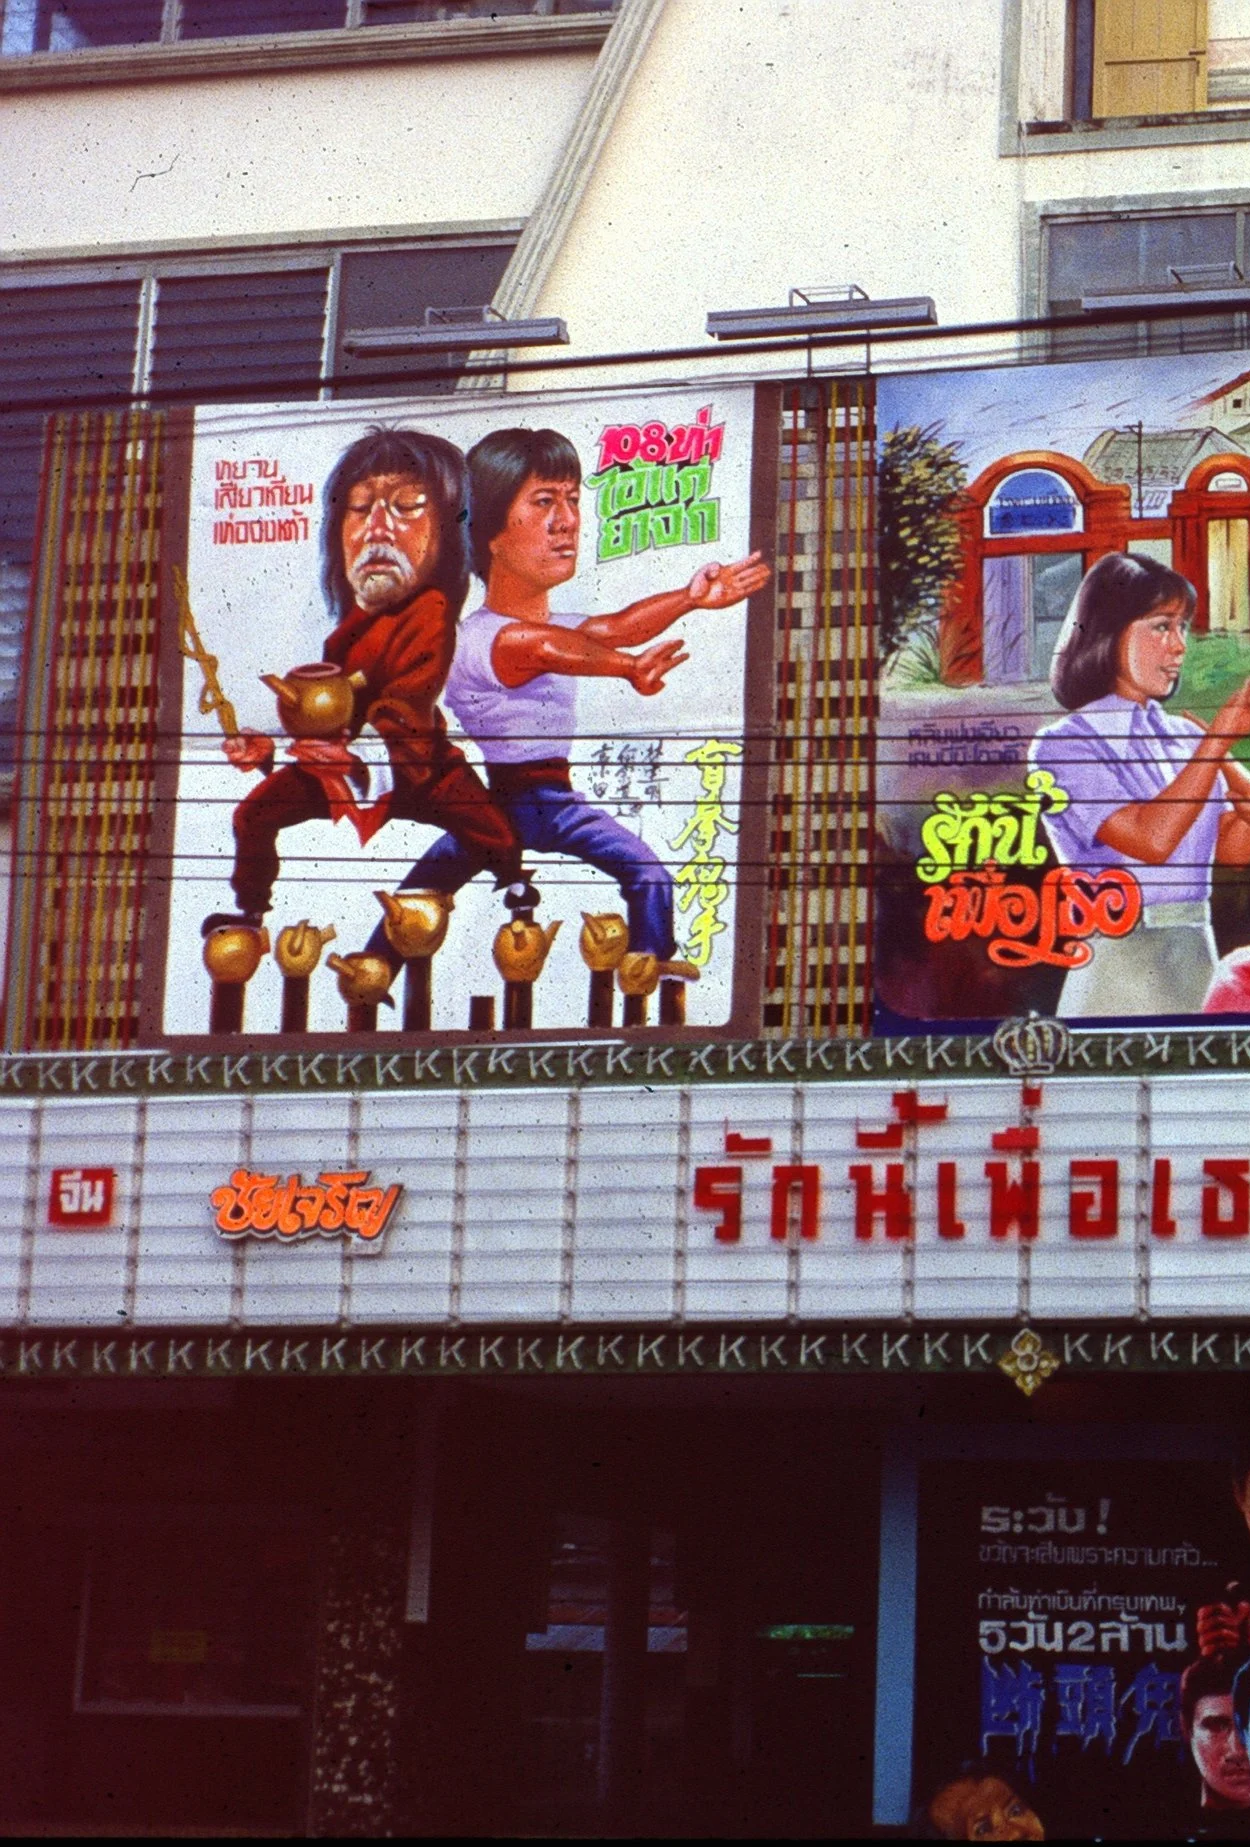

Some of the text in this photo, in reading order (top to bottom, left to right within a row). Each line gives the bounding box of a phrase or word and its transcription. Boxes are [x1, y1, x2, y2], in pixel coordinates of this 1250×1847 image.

[597, 498, 720, 563] ยาจก
[979, 1611, 1189, 1654] 5วัน2ล้าน
